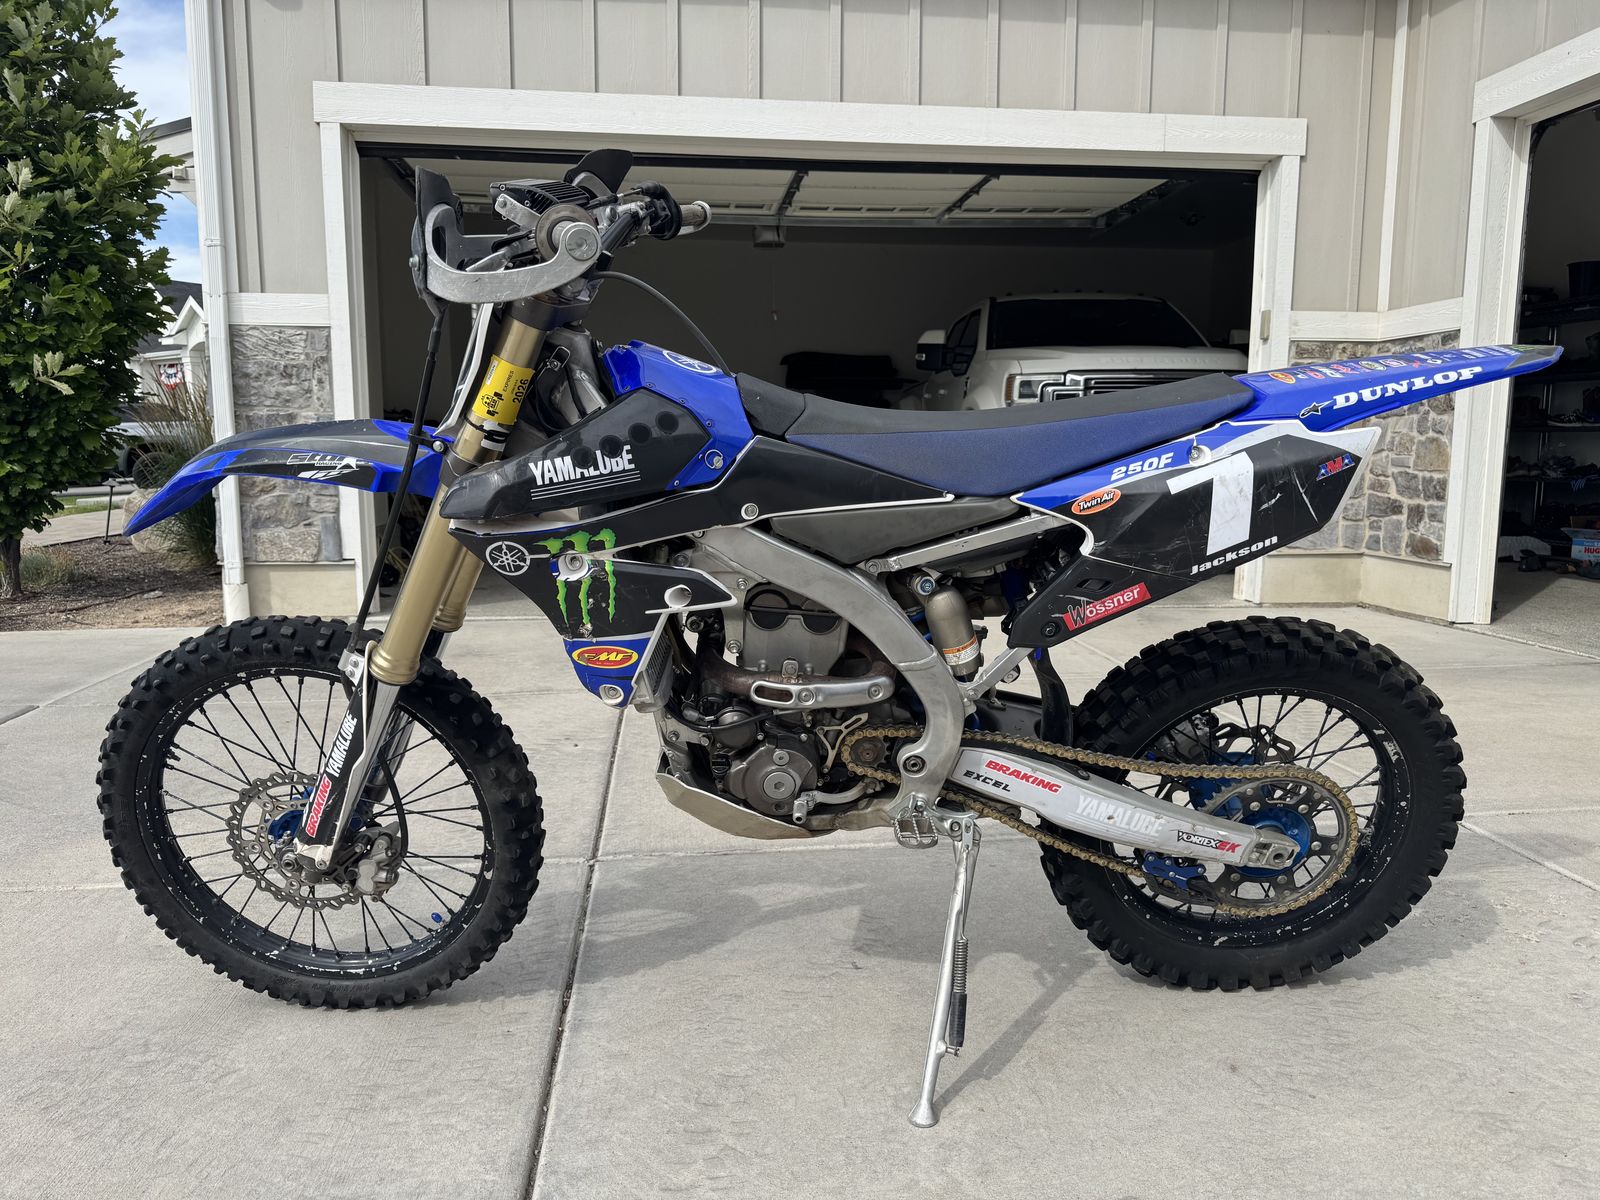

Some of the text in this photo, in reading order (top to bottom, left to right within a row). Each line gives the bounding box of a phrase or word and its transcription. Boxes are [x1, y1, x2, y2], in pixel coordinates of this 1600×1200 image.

[512, 379, 528, 404] 2026
[1332, 366, 1483, 409] DUNLOP
[1110, 452, 1174, 481] 250F
[1316, 453, 1355, 481] AMA
[1078, 490, 1115, 512] Twin Air
[1166, 451, 1254, 556] 1
[1067, 587, 1140, 628] Wössner
[579, 651, 634, 661] FMF
[325, 709, 358, 778] YAMALUBE
[963, 769, 1011, 792] EXCEL
[984, 759, 1062, 793] BRAKING
[306, 775, 332, 837] BRAKING
[1076, 795, 1166, 837] YAMALUBE
